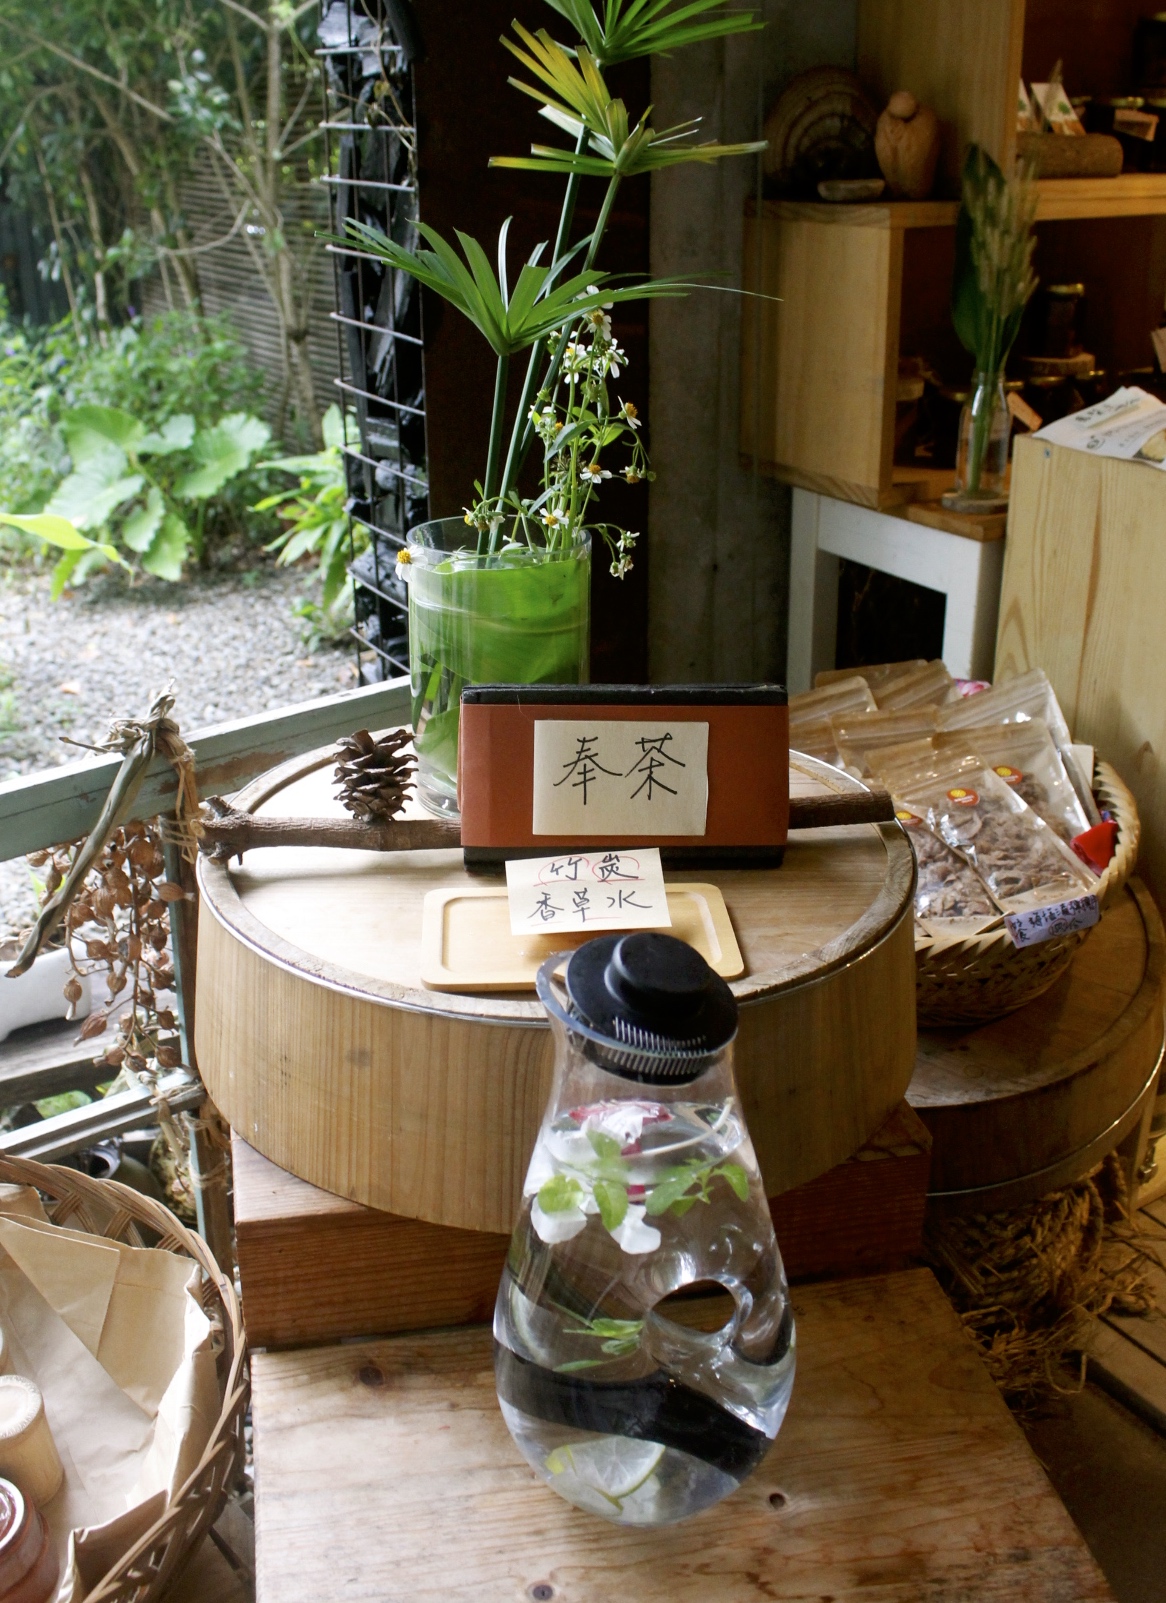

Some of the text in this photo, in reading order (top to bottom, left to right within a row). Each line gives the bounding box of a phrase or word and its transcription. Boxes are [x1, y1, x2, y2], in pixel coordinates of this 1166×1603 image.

[552, 732, 686, 806] 奉茶
[549, 853, 640, 883] 竹炭
[527, 887, 653, 923] 香草水
